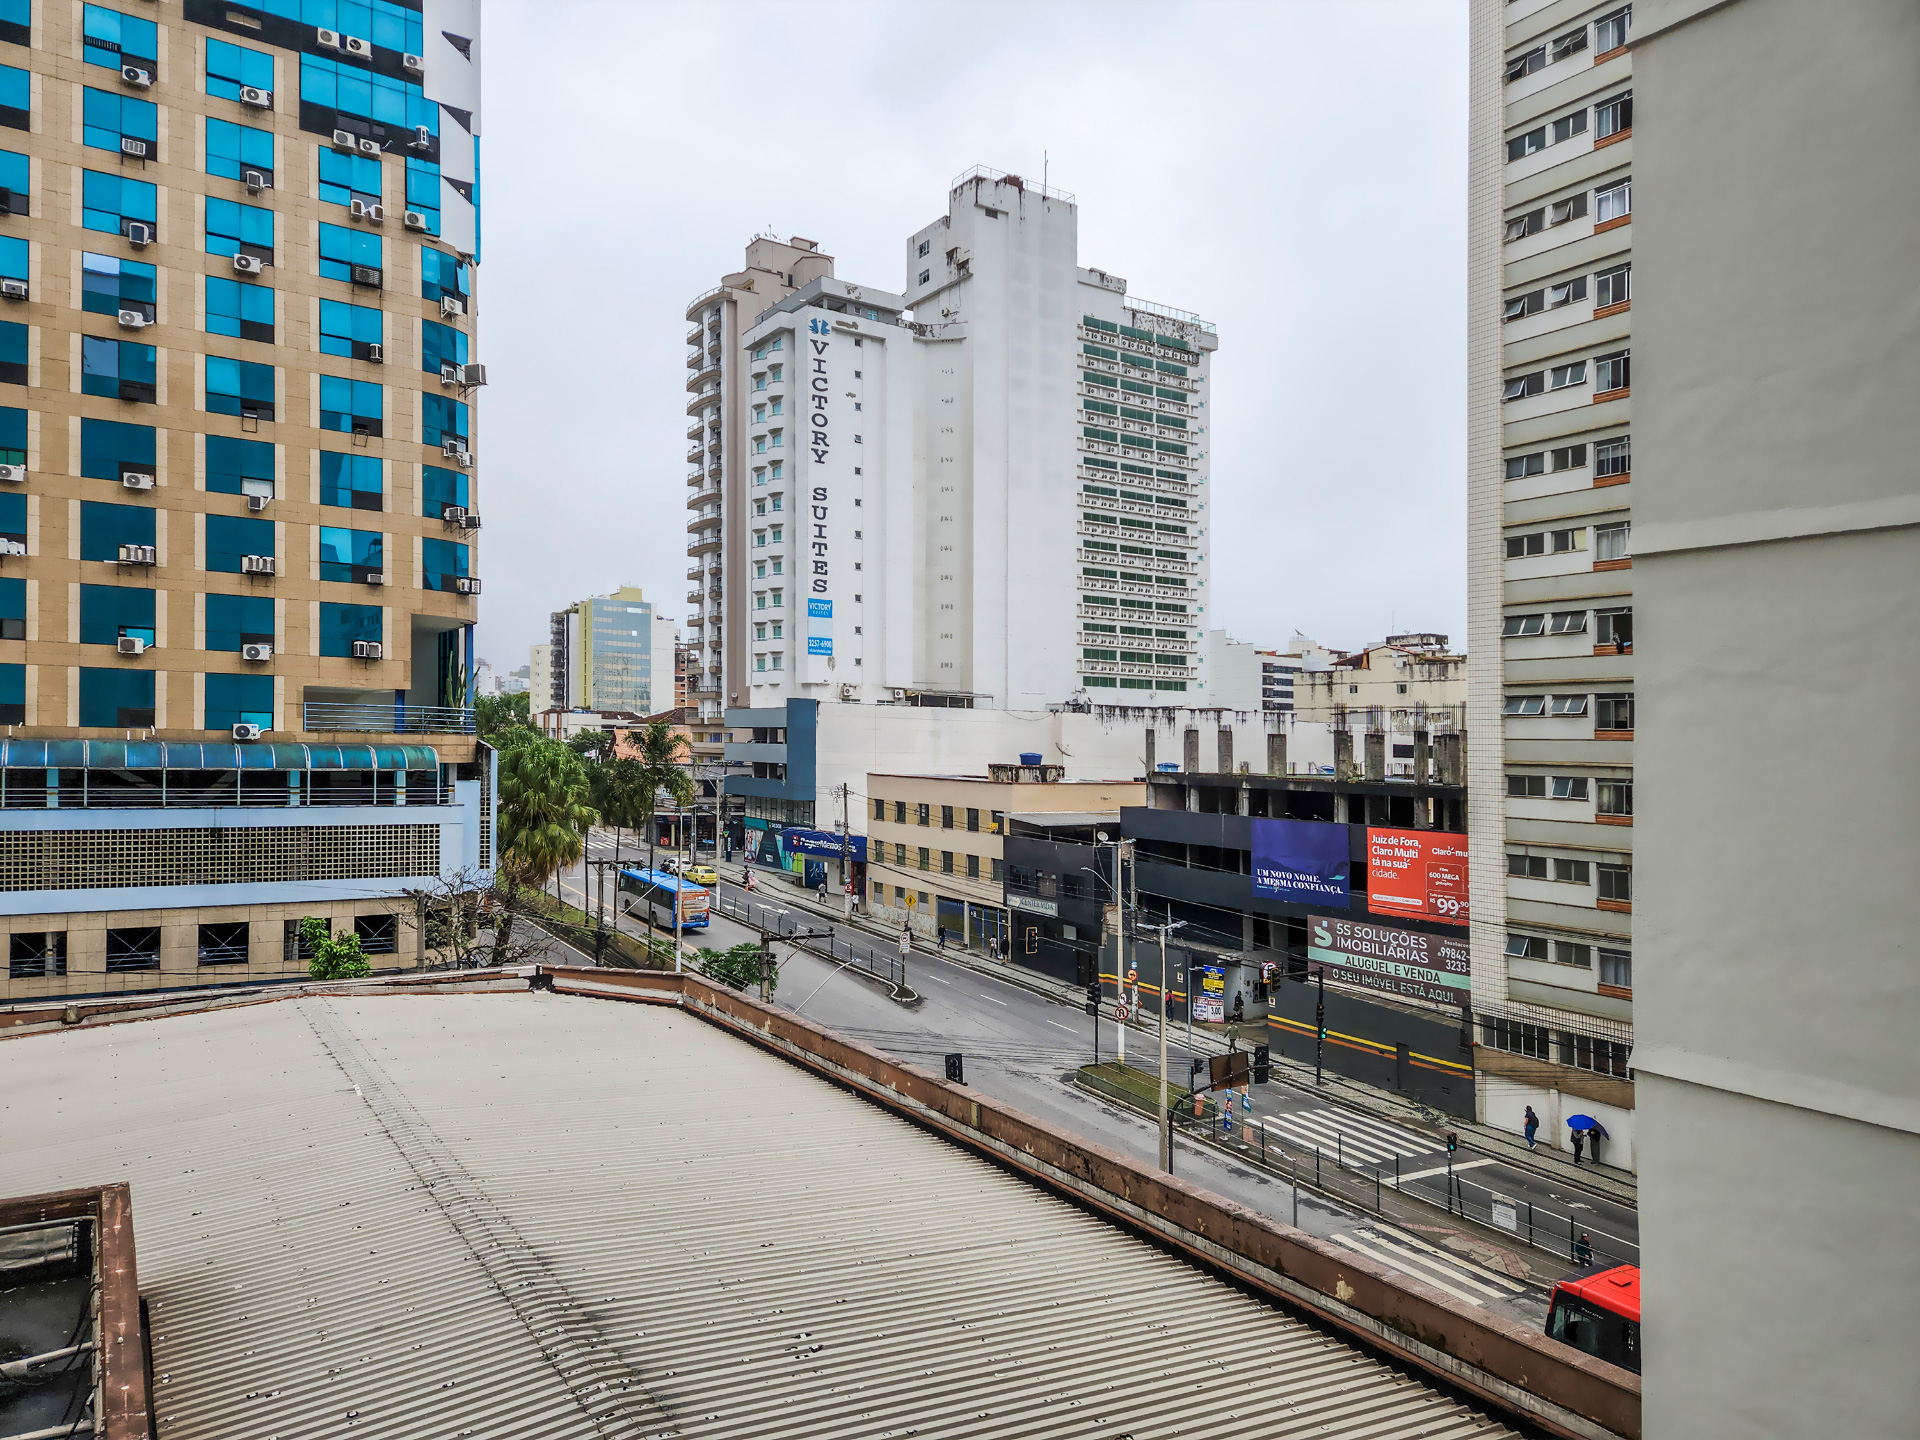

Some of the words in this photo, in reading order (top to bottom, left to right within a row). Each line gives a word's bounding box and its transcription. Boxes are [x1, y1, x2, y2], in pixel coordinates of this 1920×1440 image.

[811, 339, 830, 464] VICTORY
[812, 487, 828, 593] SUITES
[809, 602, 831, 611] VICTORY
[1371, 834, 1387, 844] Juiz
[1388, 836, 1399, 845] de
[1400, 837, 1422, 849] Fora,
[1372, 846, 1393, 856] Claro
[1394, 848, 1419, 859] Multi
[1372, 857, 1380, 866] tá
[1381, 859, 1392, 867] na
[1257, 868, 1269, 877] UM
[1270, 870, 1293, 880] NOVO
[1294, 872, 1321, 883] NOME.
[1371, 869, 1400, 880] cidade.
[1441, 873, 1460, 881] MEGA
[1263, 877, 1292, 888] MESMA
[1293, 880, 1344, 895] CONFIANÇA.
[1354, 927, 1428, 949] SOLUÇÕES
[1336, 936, 1429, 964] IMOBILIÁRIAS
[1344, 955, 1392, 974] ALUGUEL
[1394, 964, 1401, 975] E
[1403, 966, 1441, 984] VENDA
[1332, 968, 1339, 979] O
[1340, 970, 1360, 983] SEU
[1362, 973, 1398, 992] IMÓVEL
[1400, 982, 1426, 996] ESTÁ
[1428, 988, 1457, 1004] AQUI.
[1211, 1006, 1221, 1016] 3,00
